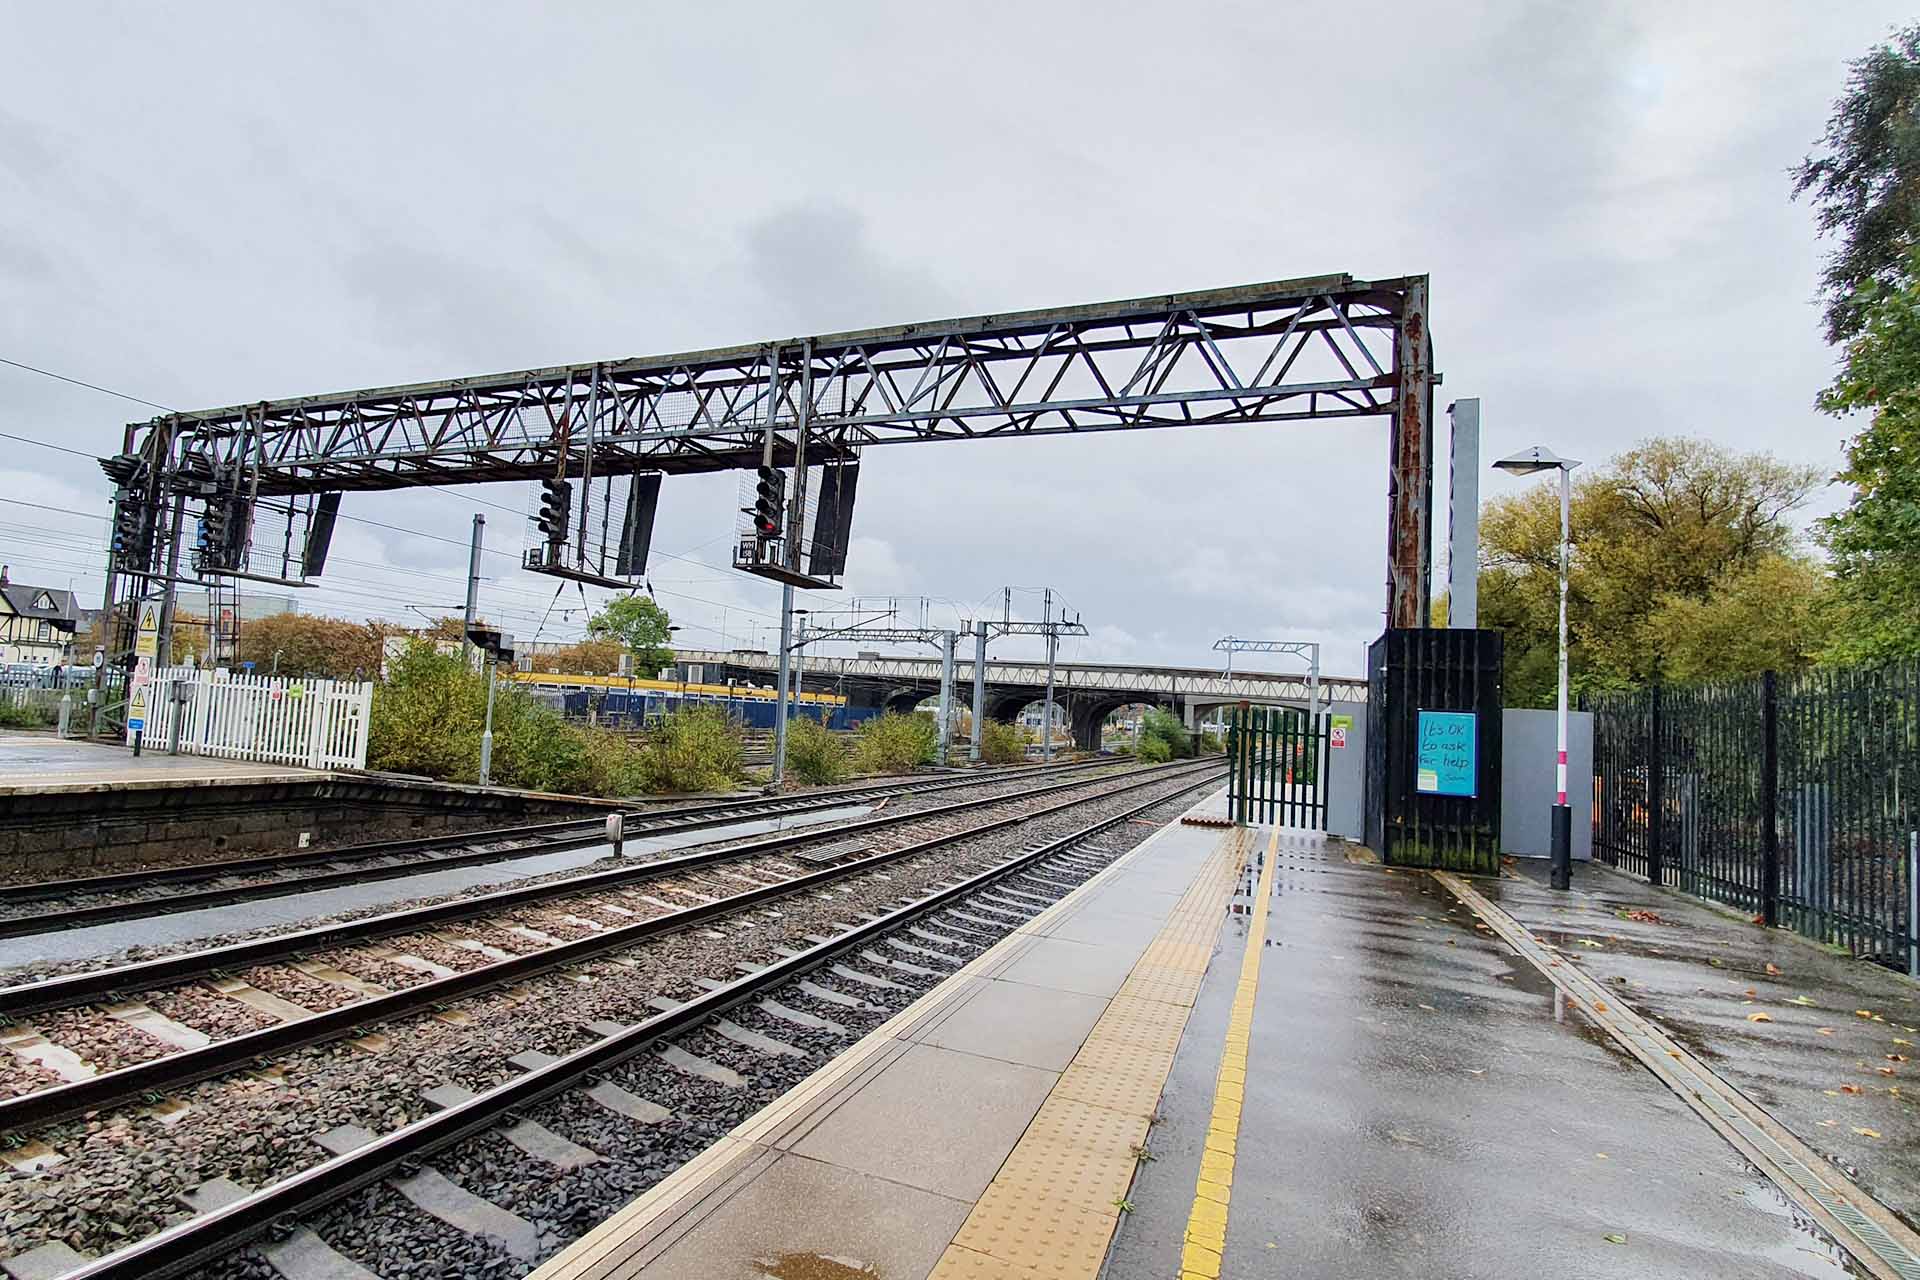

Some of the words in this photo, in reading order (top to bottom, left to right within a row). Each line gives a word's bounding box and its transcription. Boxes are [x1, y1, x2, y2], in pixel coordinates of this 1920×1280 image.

[742, 541, 754, 549] WH
[1447, 723, 1465, 737] OK
[1422, 737, 1438, 752] to
[1441, 740, 1467, 753] ask
[1442, 753, 1470, 772] help
